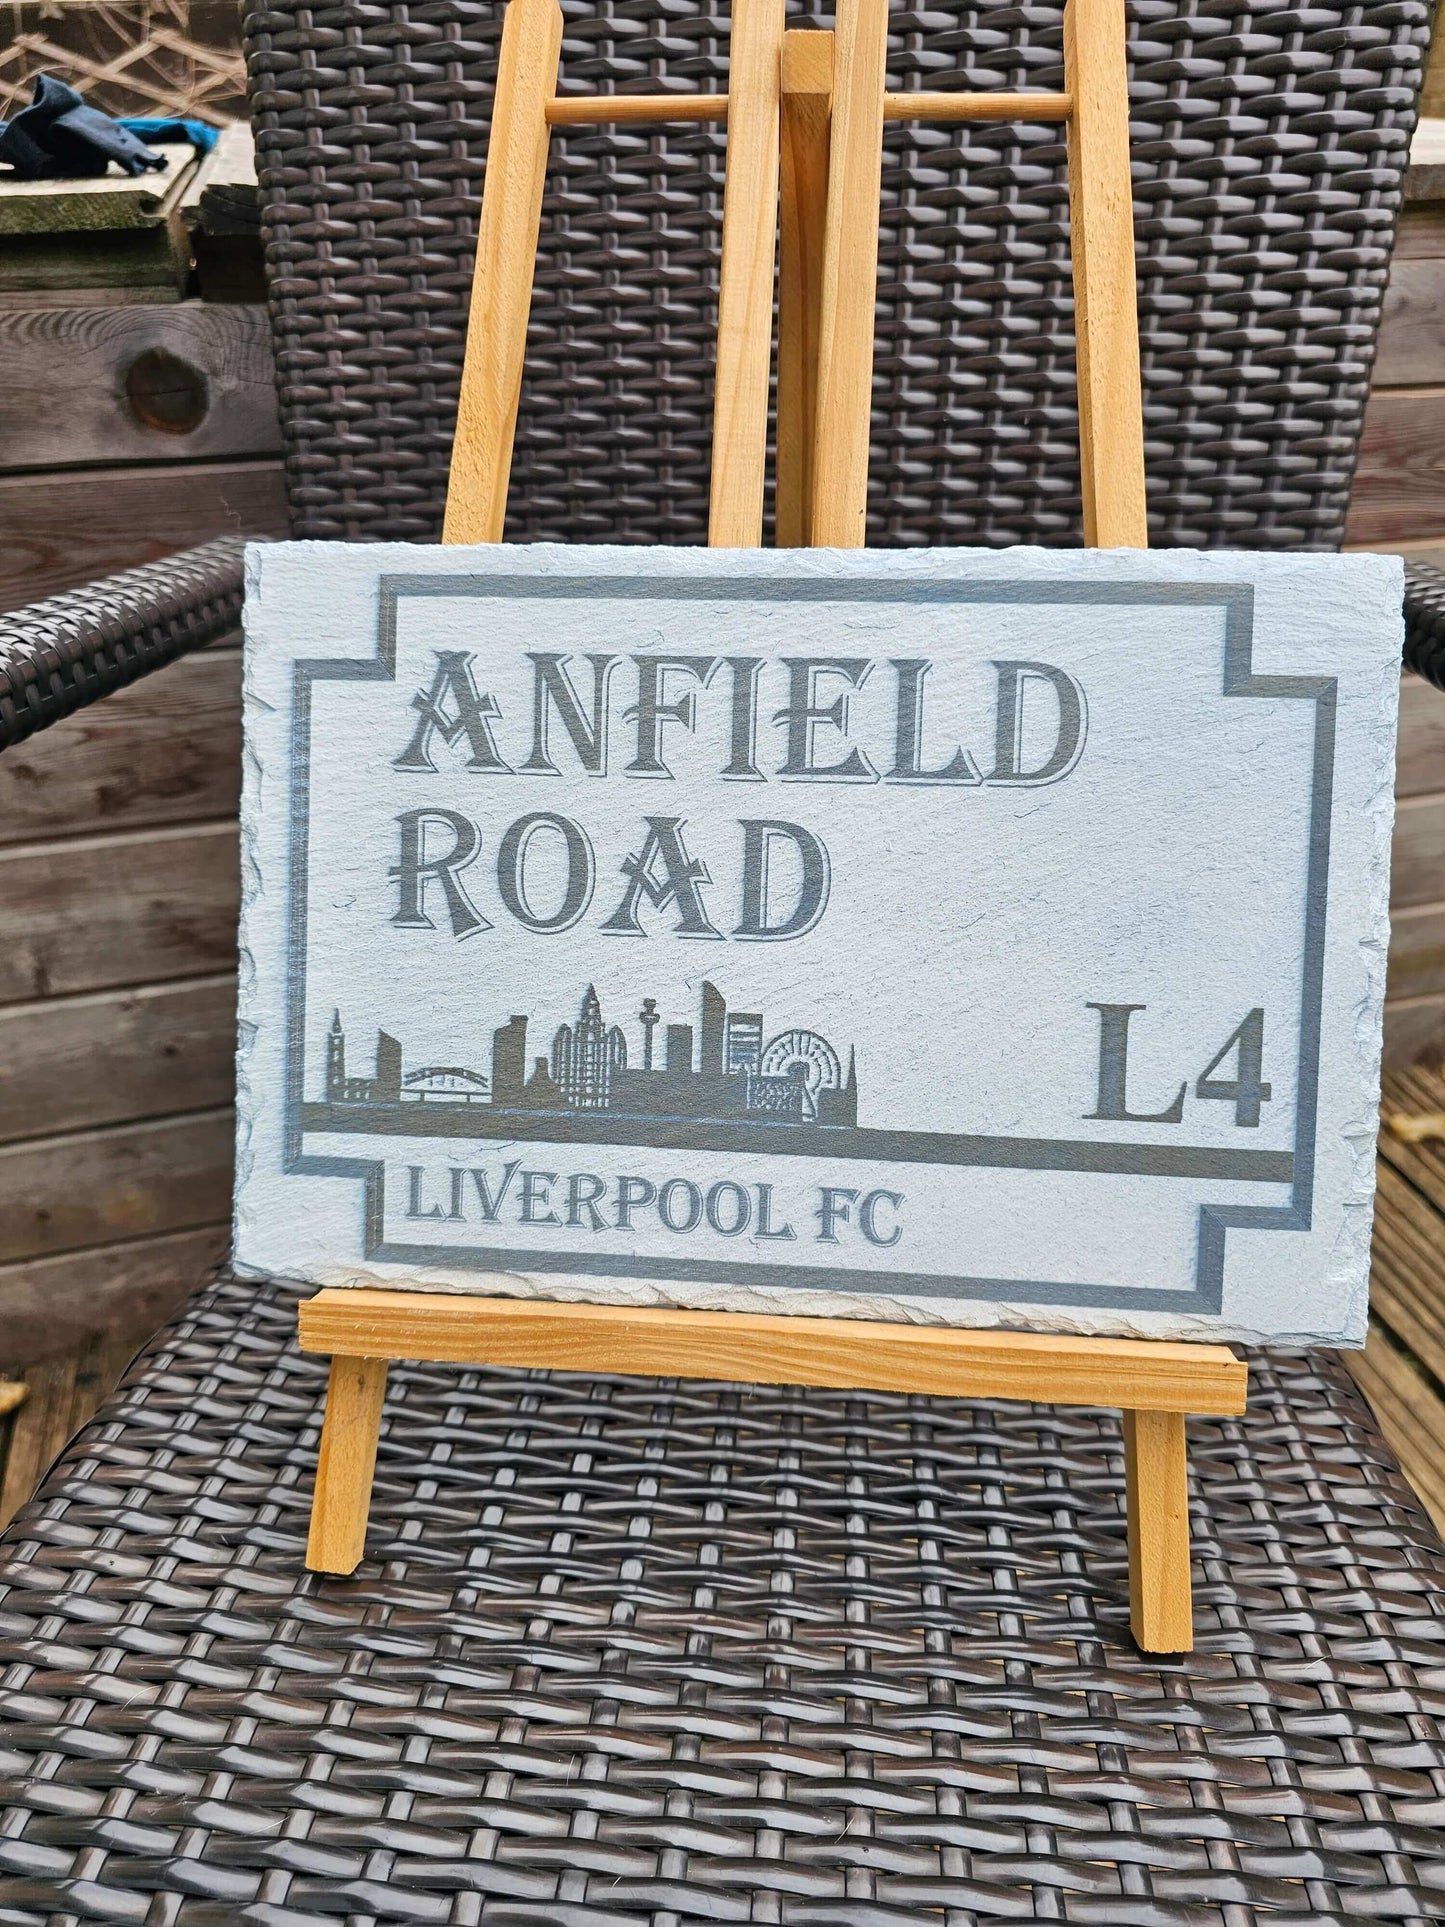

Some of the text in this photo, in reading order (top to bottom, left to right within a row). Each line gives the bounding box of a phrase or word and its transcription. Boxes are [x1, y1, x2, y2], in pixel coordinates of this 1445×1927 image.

[392, 649, 1089, 788] ANFIELD
[388, 807, 832, 942] ROAD
[1082, 1002, 1272, 1128] L4
[404, 1159, 906, 1248] LIVERPOOL FC
